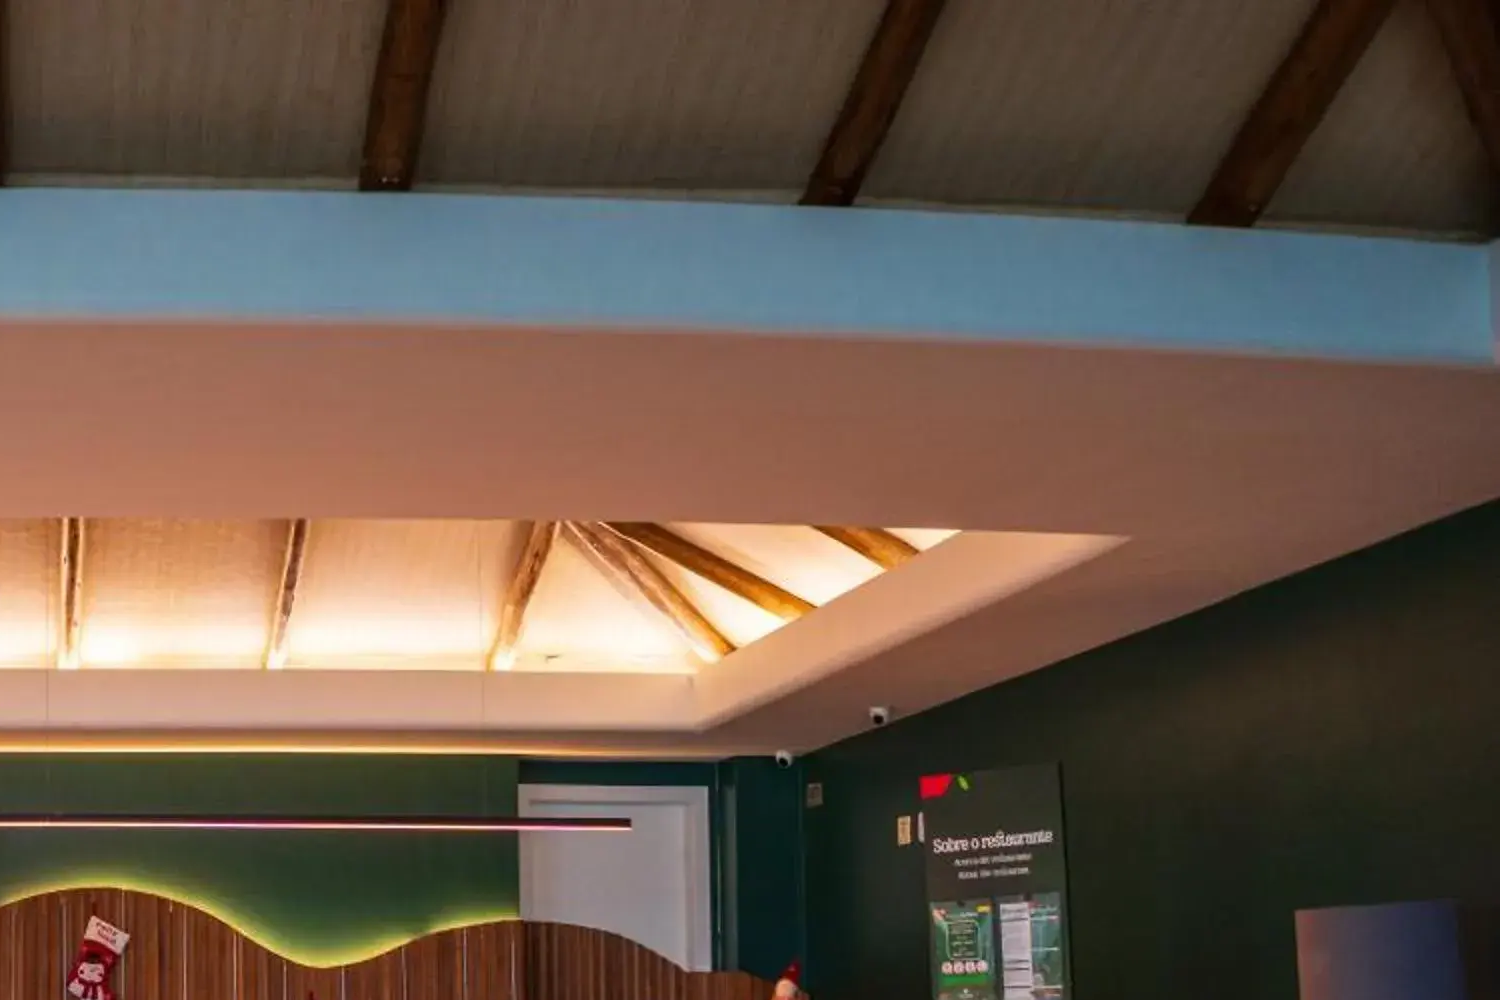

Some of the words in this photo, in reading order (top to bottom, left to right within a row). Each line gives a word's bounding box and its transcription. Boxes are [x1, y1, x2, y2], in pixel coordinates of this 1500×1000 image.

[932, 837, 969, 853] Sobre
[971, 838, 980, 849] o
[981, 829, 1054, 849] restaurante
